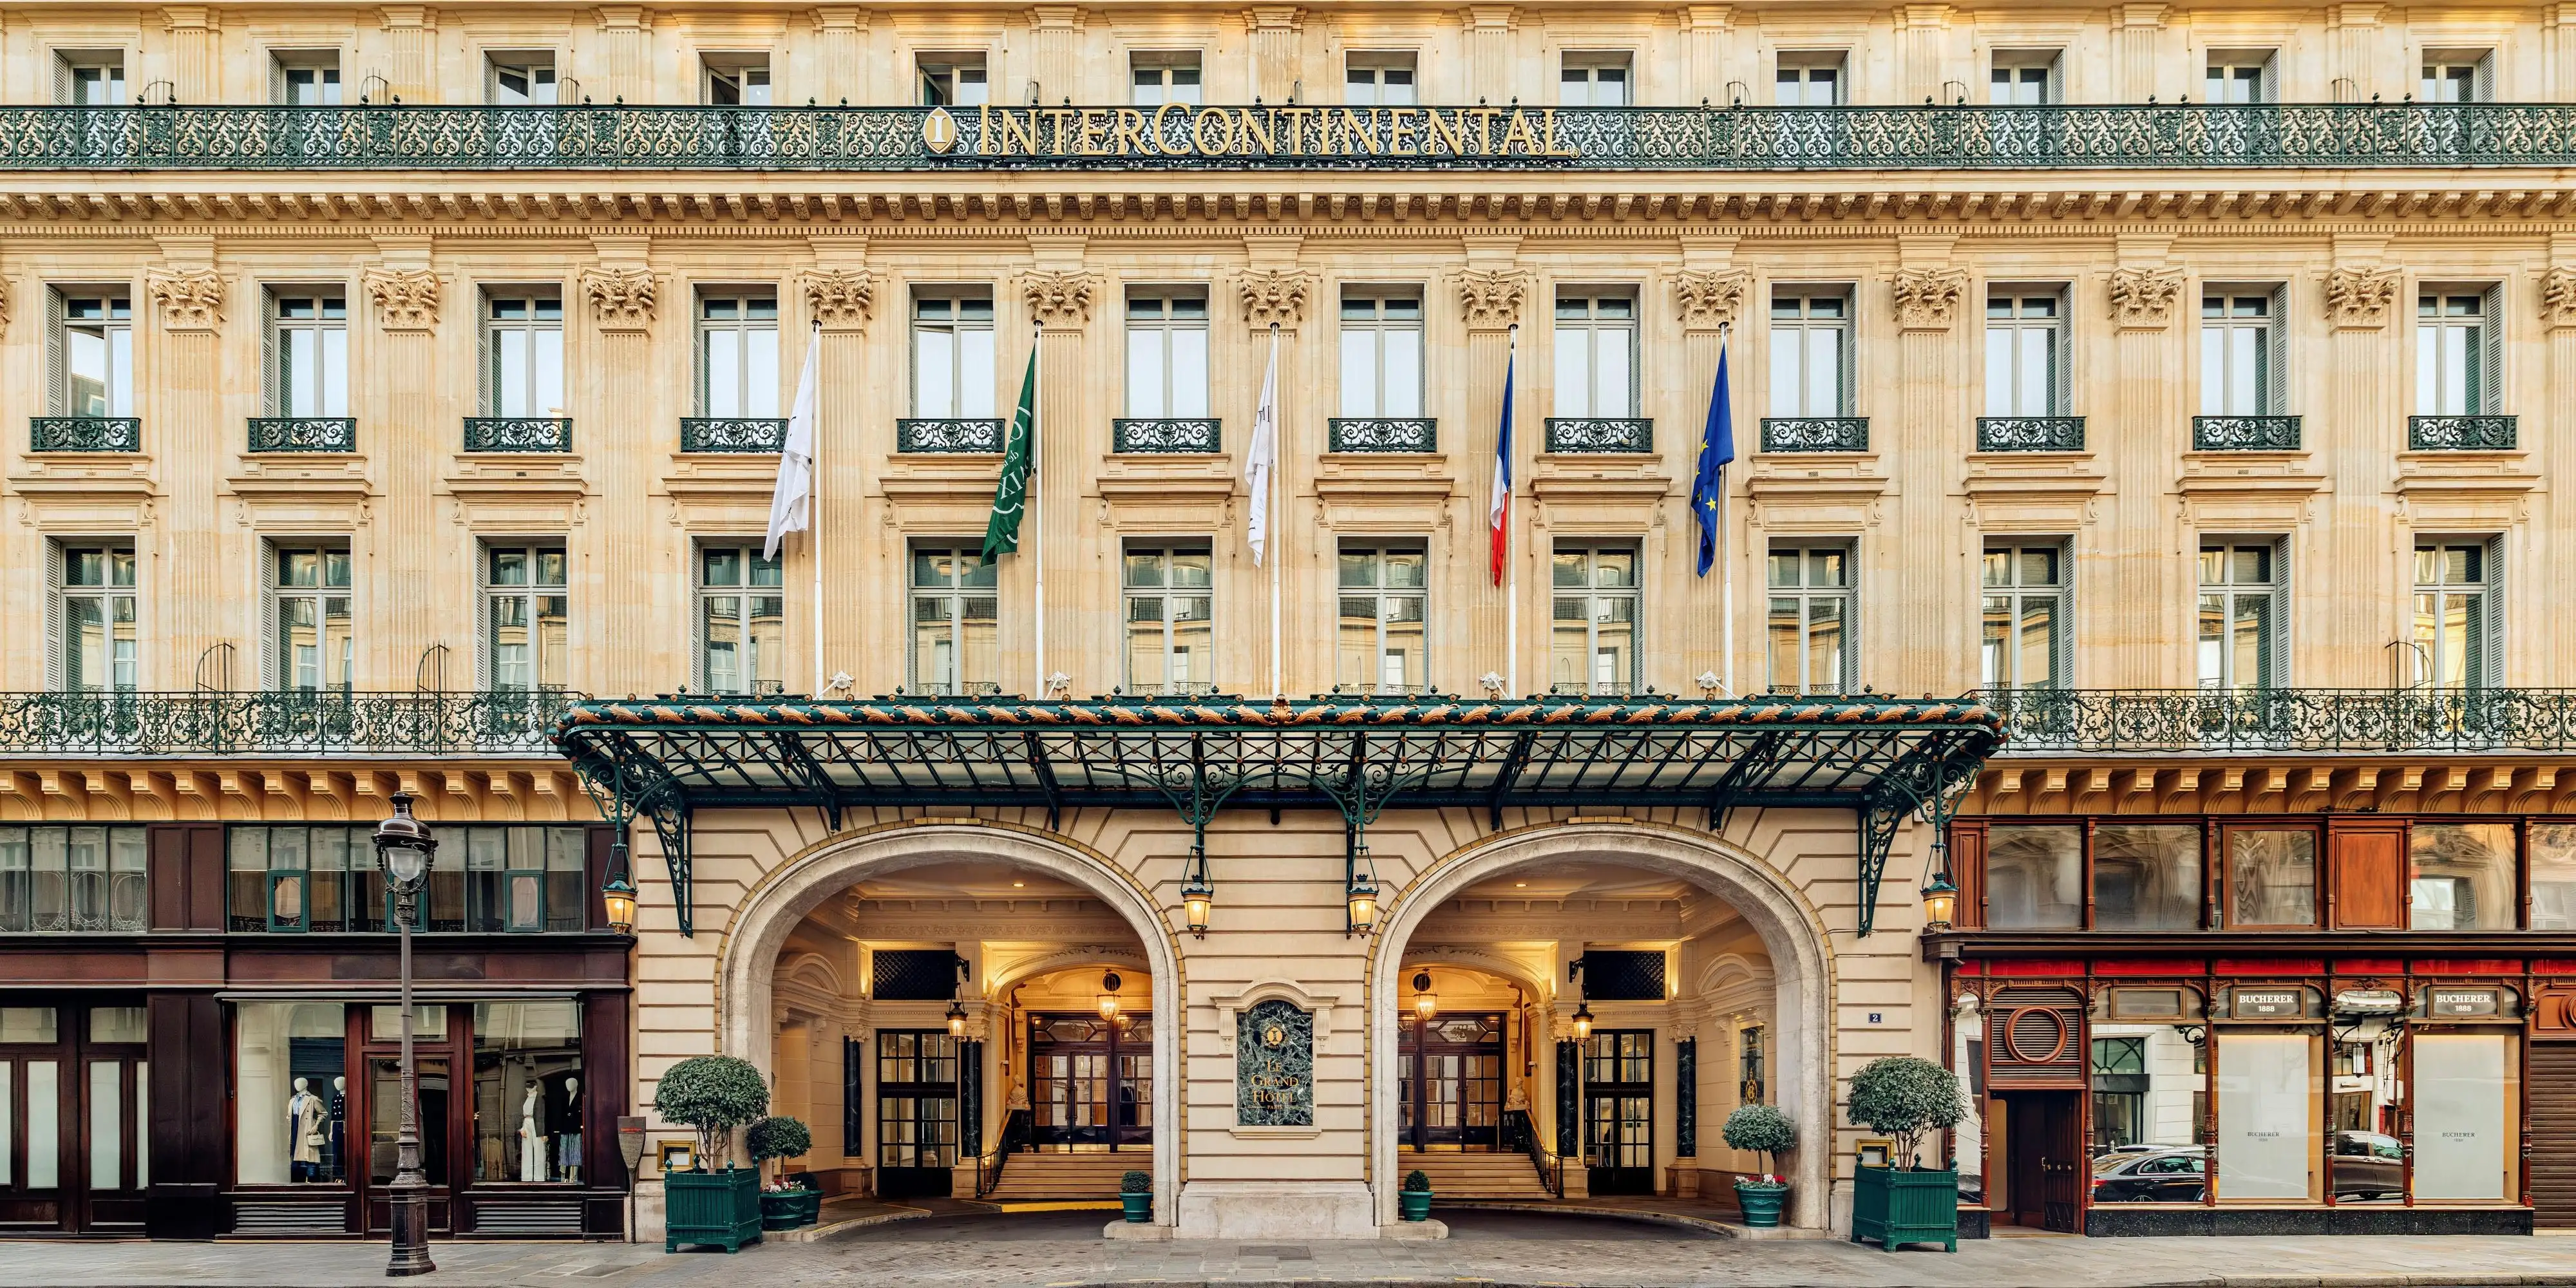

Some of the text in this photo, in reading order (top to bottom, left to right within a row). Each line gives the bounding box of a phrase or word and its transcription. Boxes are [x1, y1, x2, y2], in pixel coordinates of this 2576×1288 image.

[2239, 995, 2294, 1003] BUCHERER
[2436, 994, 2491, 1003] BUCHERER
[1267, 1059, 1282, 1072] LE
[1251, 1074, 1299, 1086] GRAND
